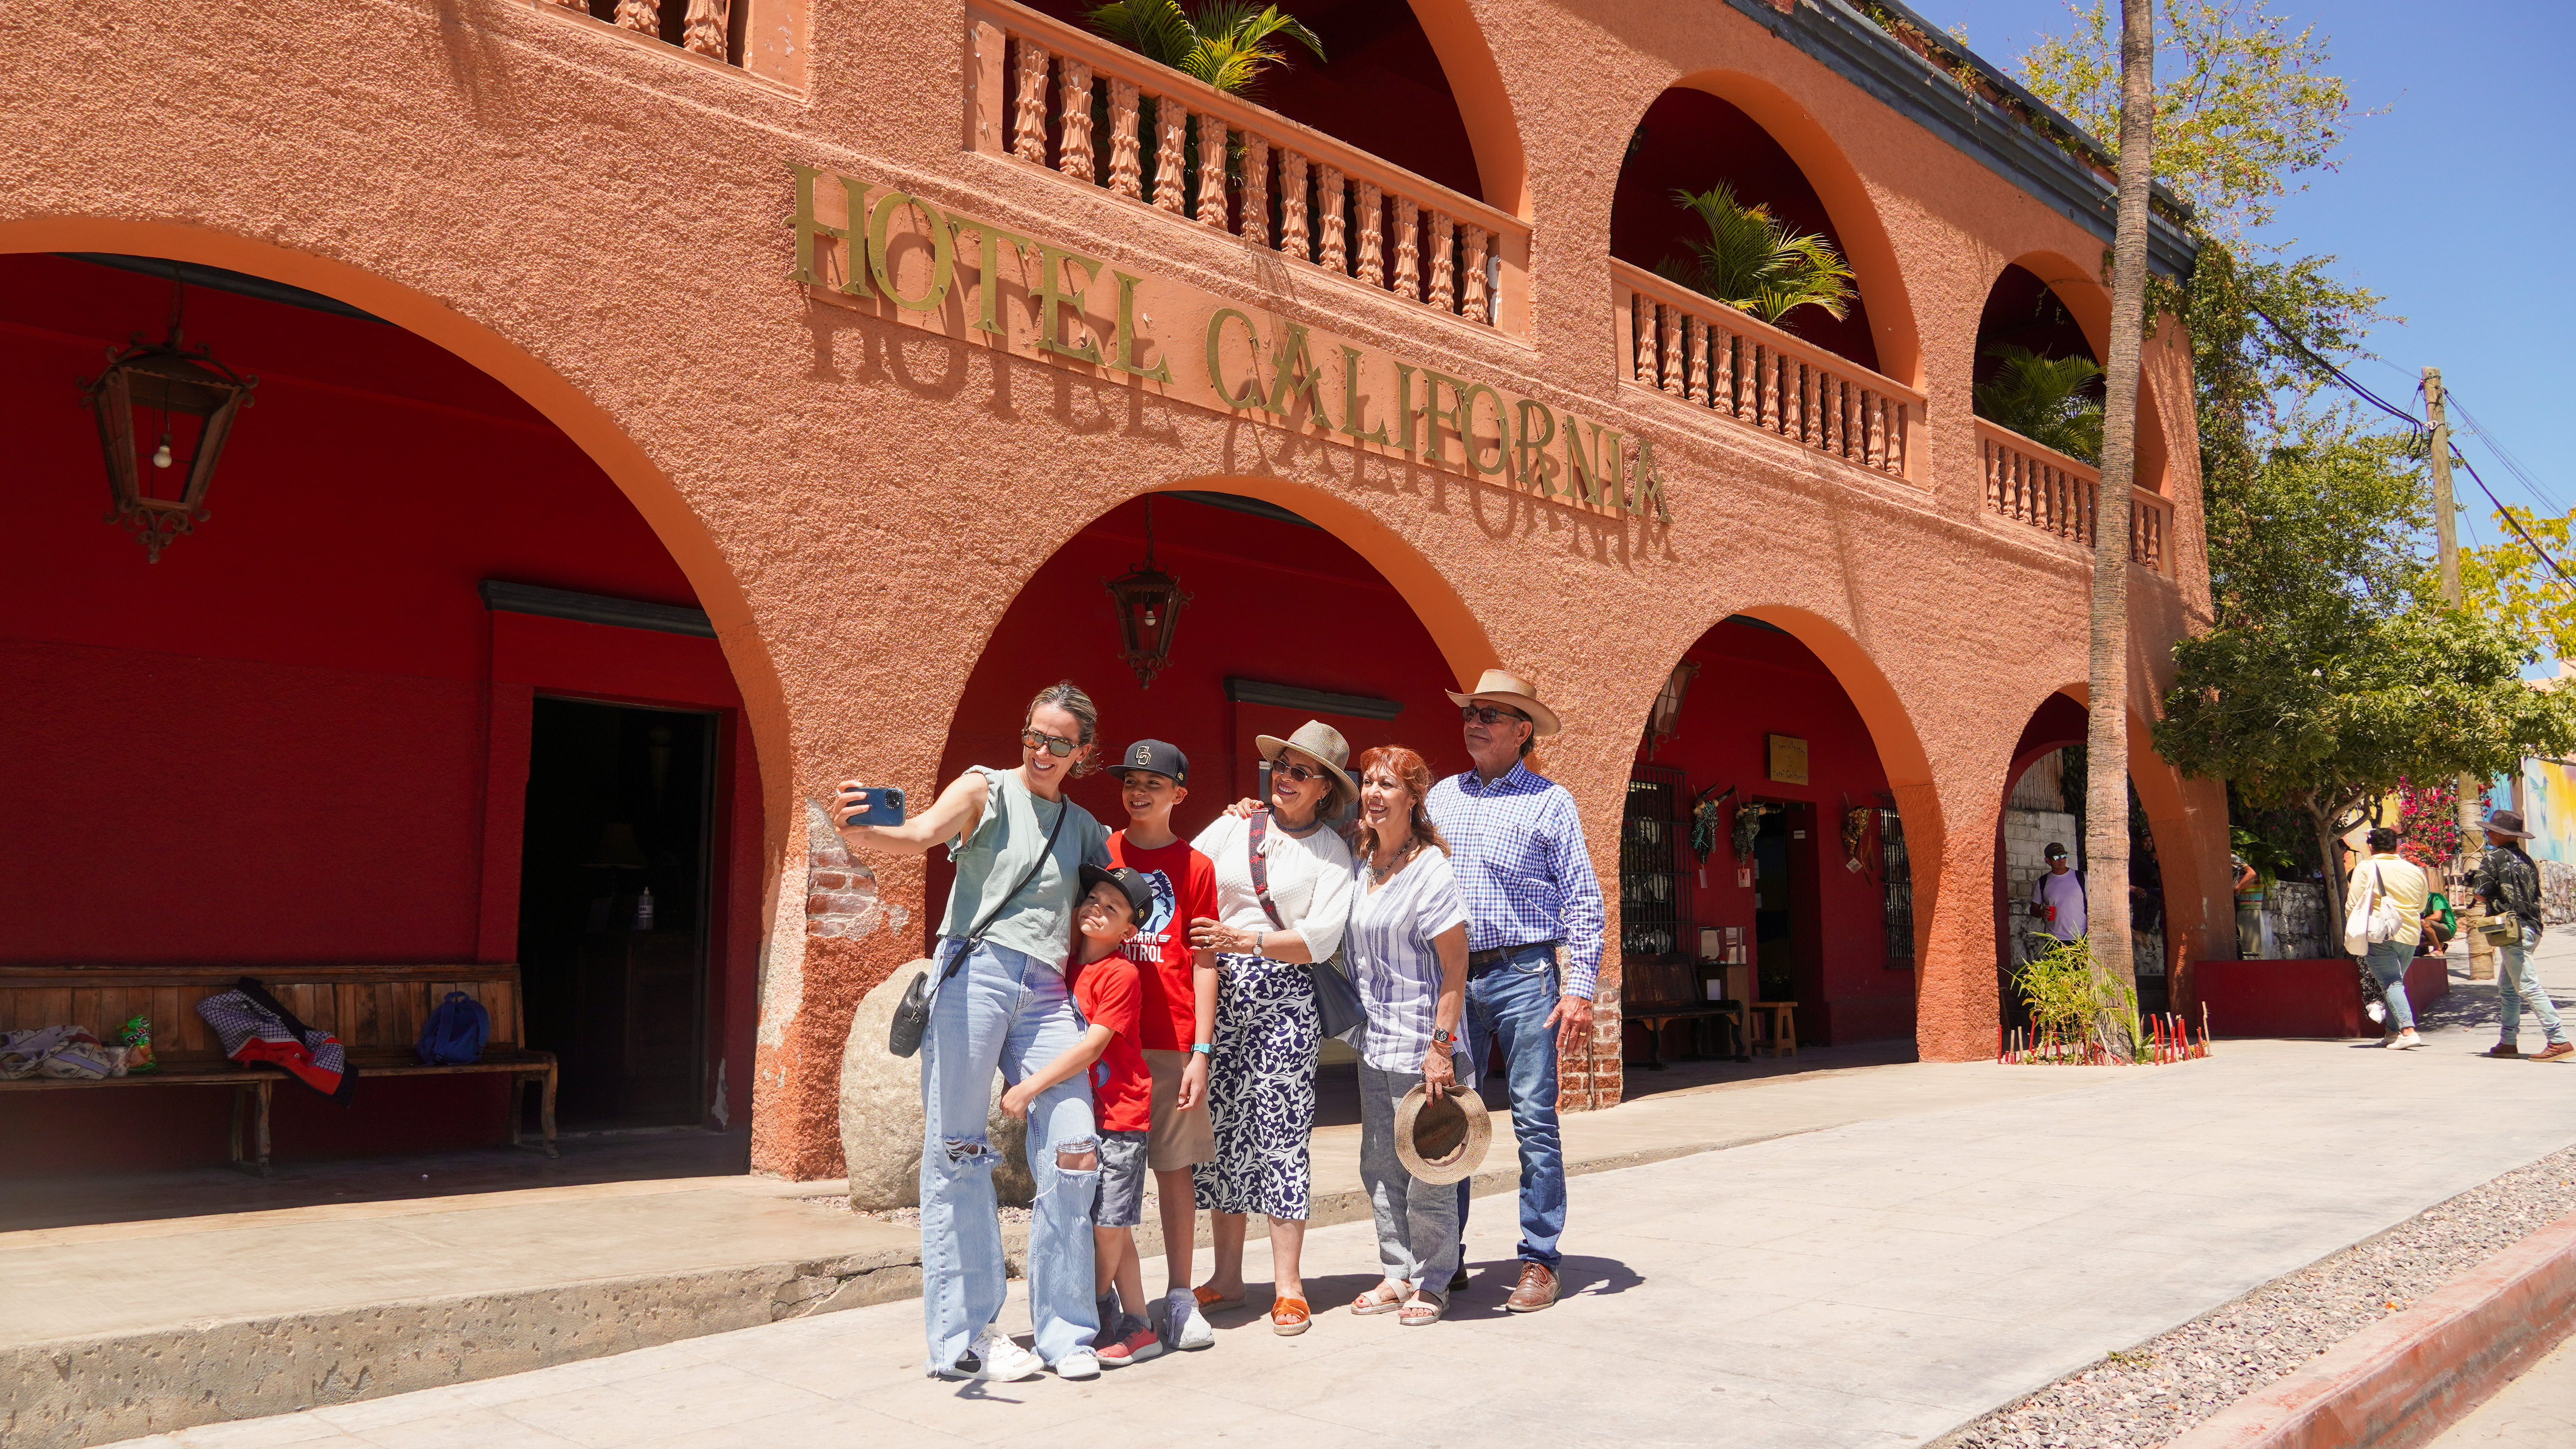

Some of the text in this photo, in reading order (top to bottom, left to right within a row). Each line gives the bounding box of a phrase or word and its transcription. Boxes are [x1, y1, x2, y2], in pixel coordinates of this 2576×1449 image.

[781, 160, 1674, 524] HOTEL CALIFORNIA
[1118, 943, 1164, 963] PATROL
